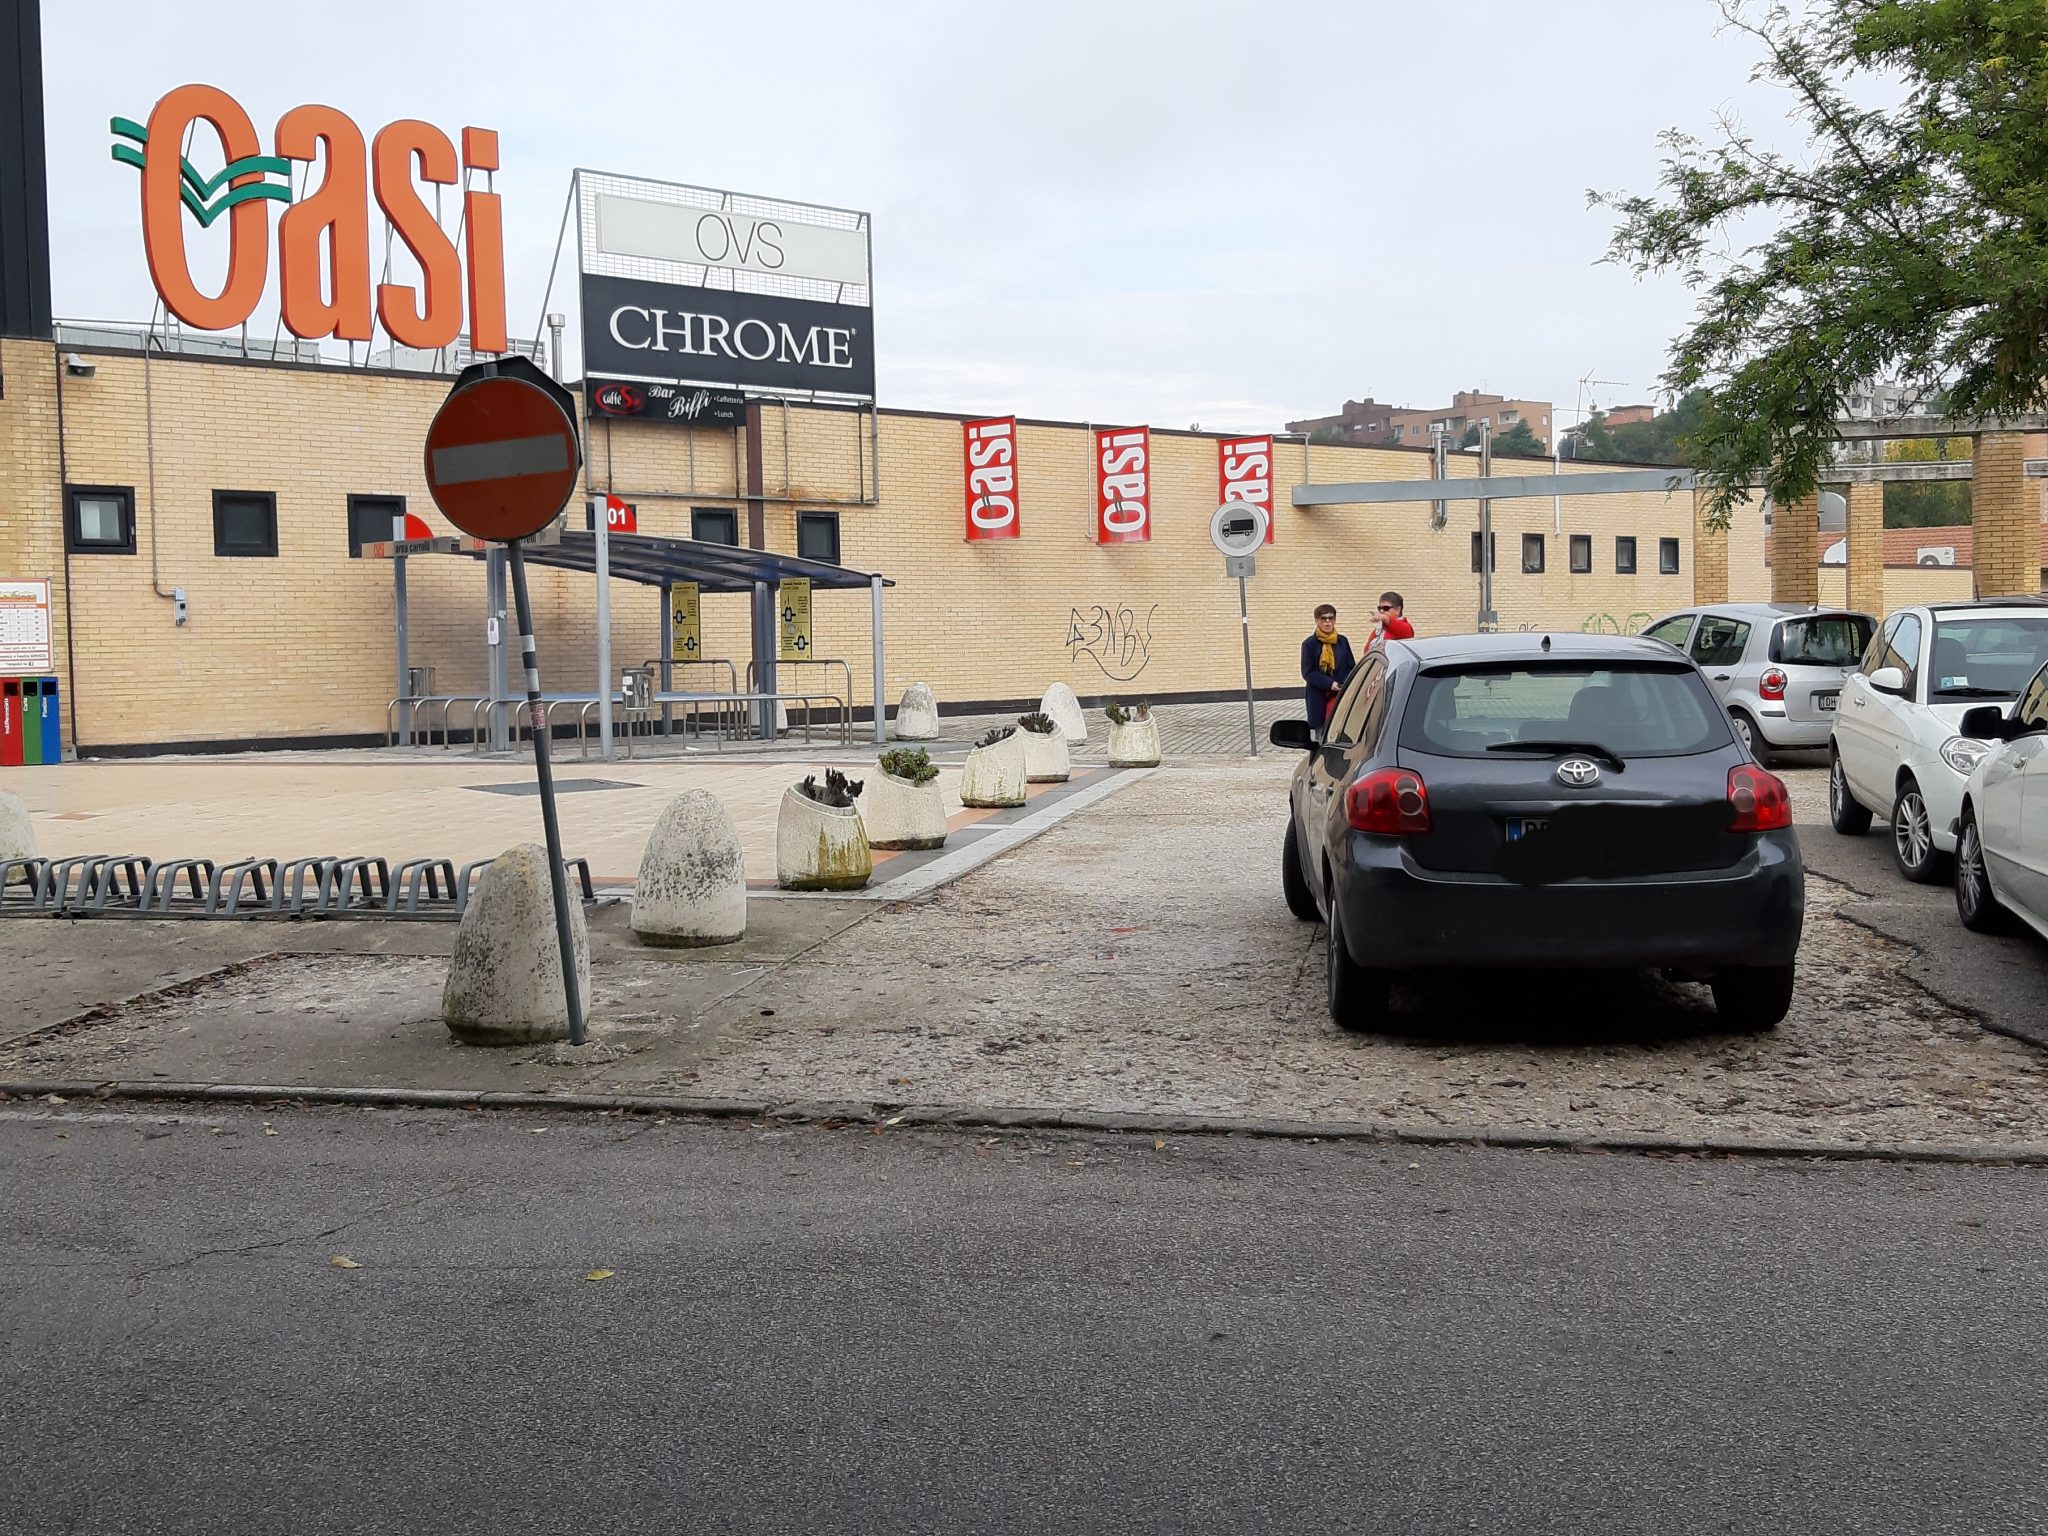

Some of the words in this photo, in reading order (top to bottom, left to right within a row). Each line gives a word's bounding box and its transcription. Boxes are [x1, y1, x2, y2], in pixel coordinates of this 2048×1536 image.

[141, 83, 507, 352] Oasi
[696, 214, 785, 268] OVS
[609, 305, 854, 369] CHROME
[648, 385, 676, 399] Bar
[668, 389, 712, 420] Biffi
[717, 410, 734, 418] Lunch
[1223, 441, 1269, 527] asi
[607, 507, 626, 525] 01
